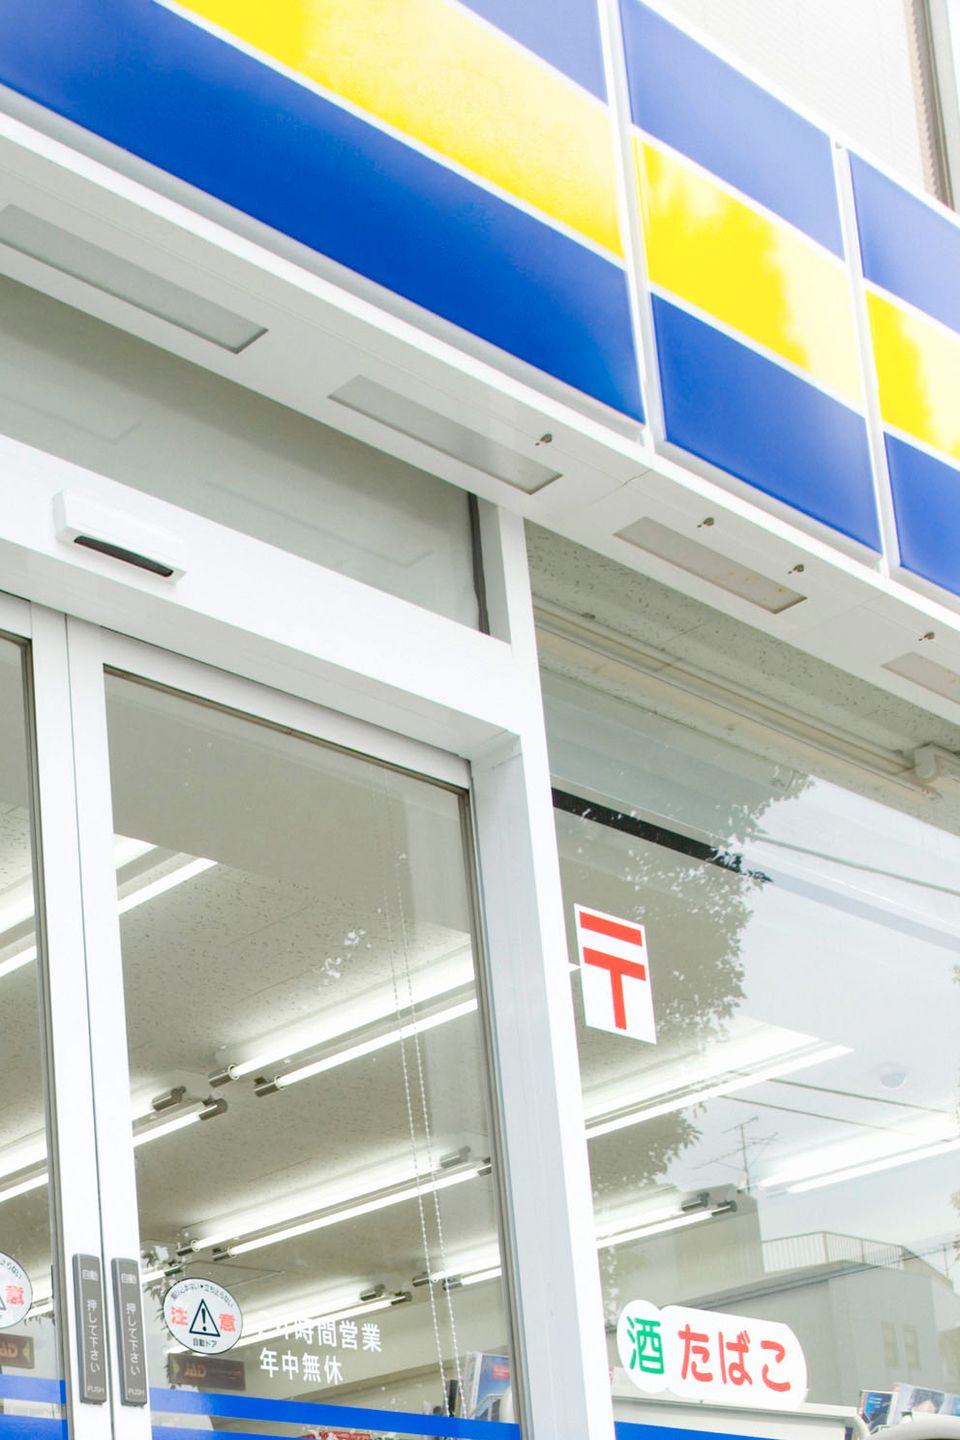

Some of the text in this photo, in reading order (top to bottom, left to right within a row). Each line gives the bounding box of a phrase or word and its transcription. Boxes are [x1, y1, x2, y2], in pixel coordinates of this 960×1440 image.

[82, 1269, 99, 1281] 自動
[120, 1272, 137, 1284] 自動
[171, 1305, 189, 1326] 注
[87, 1299, 101, 1374] 押して下さい
[127, 1302, 141, 1376] 押して下さい
[192, 1337, 218, 1348] 自動ドア
[627, 1316, 791, 1392] 酒 たばこ
[259, 1347, 344, 1385] 年中無休
[87, 1385, 105, 1394] PUSH
